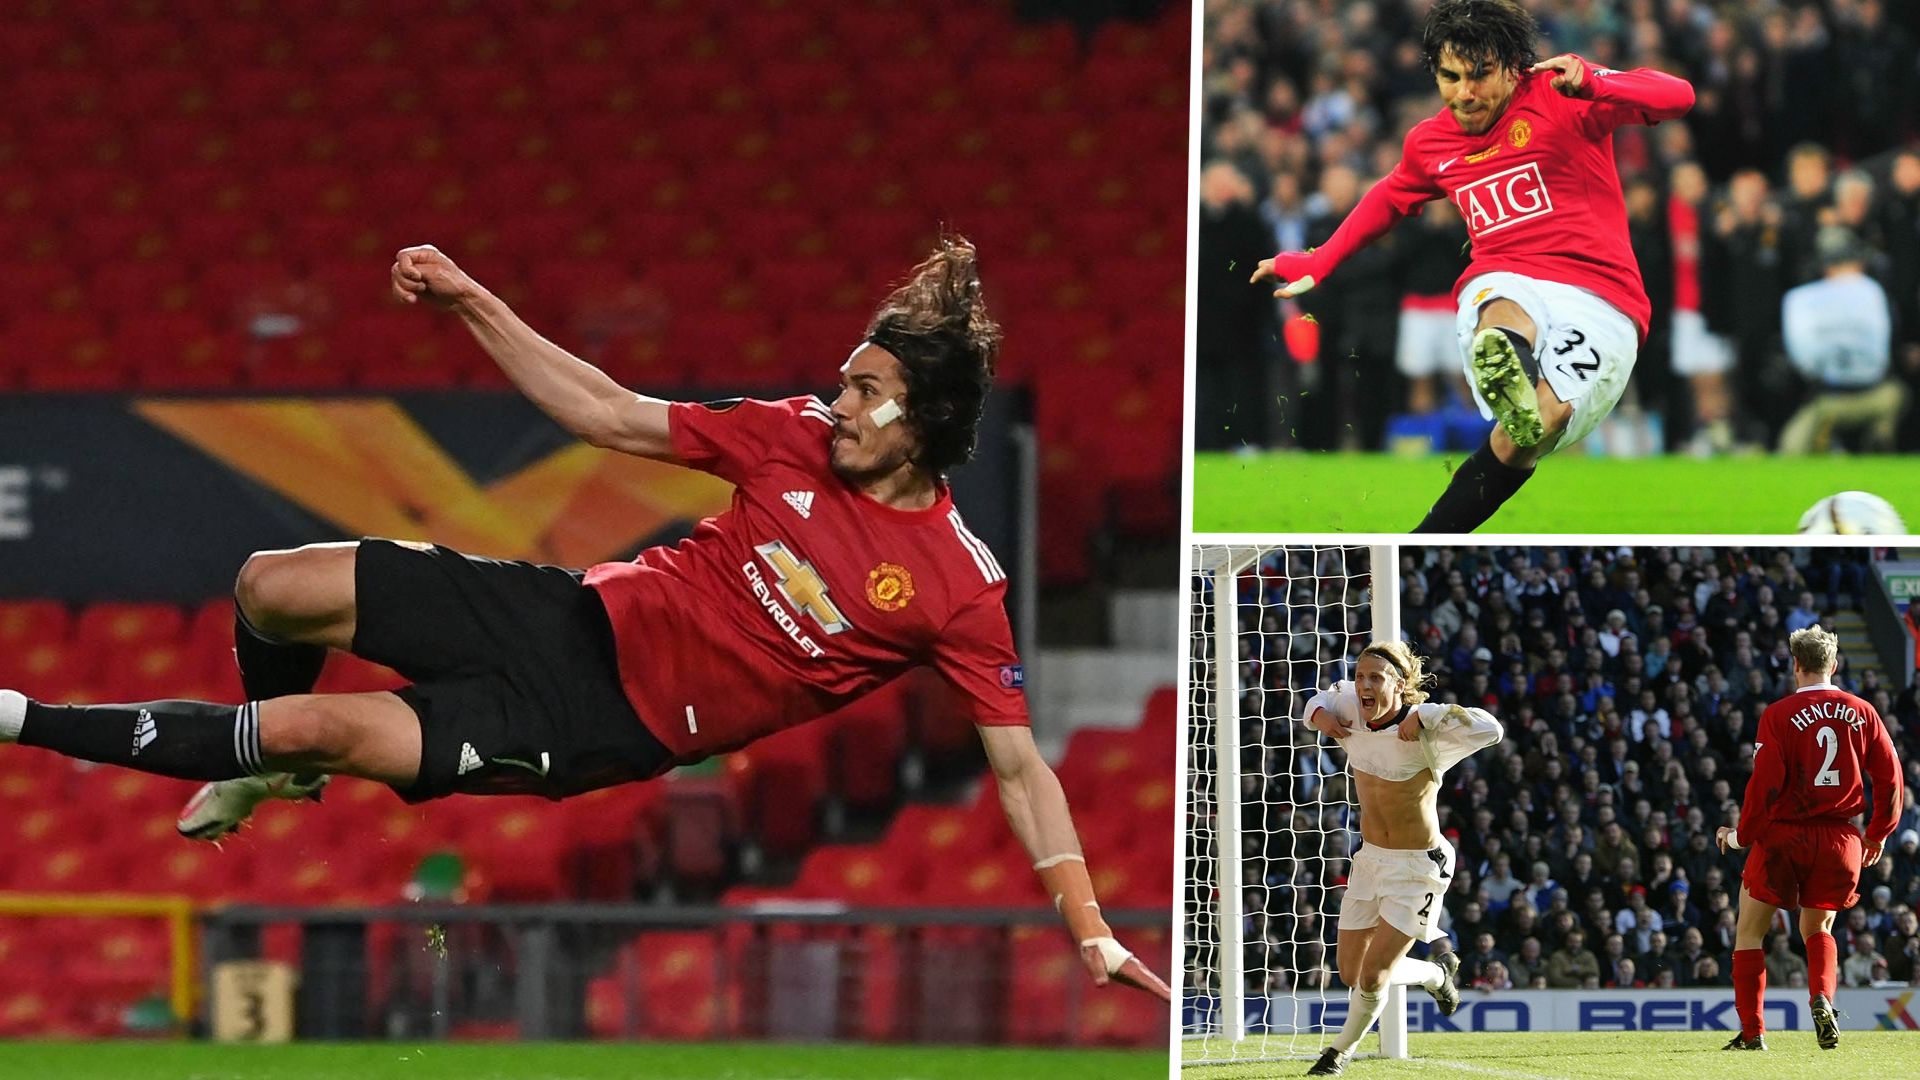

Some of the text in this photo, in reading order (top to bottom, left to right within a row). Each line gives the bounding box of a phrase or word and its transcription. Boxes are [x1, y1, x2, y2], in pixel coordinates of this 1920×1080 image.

[1469, 172, 1542, 230] AIG
[1553, 328, 1600, 381] 32
[742, 561, 825, 658] CHEVROLET
[132, 709, 147, 756] adidas
[1814, 726, 1840, 786] 2
[1417, 892, 1433, 918] 2
